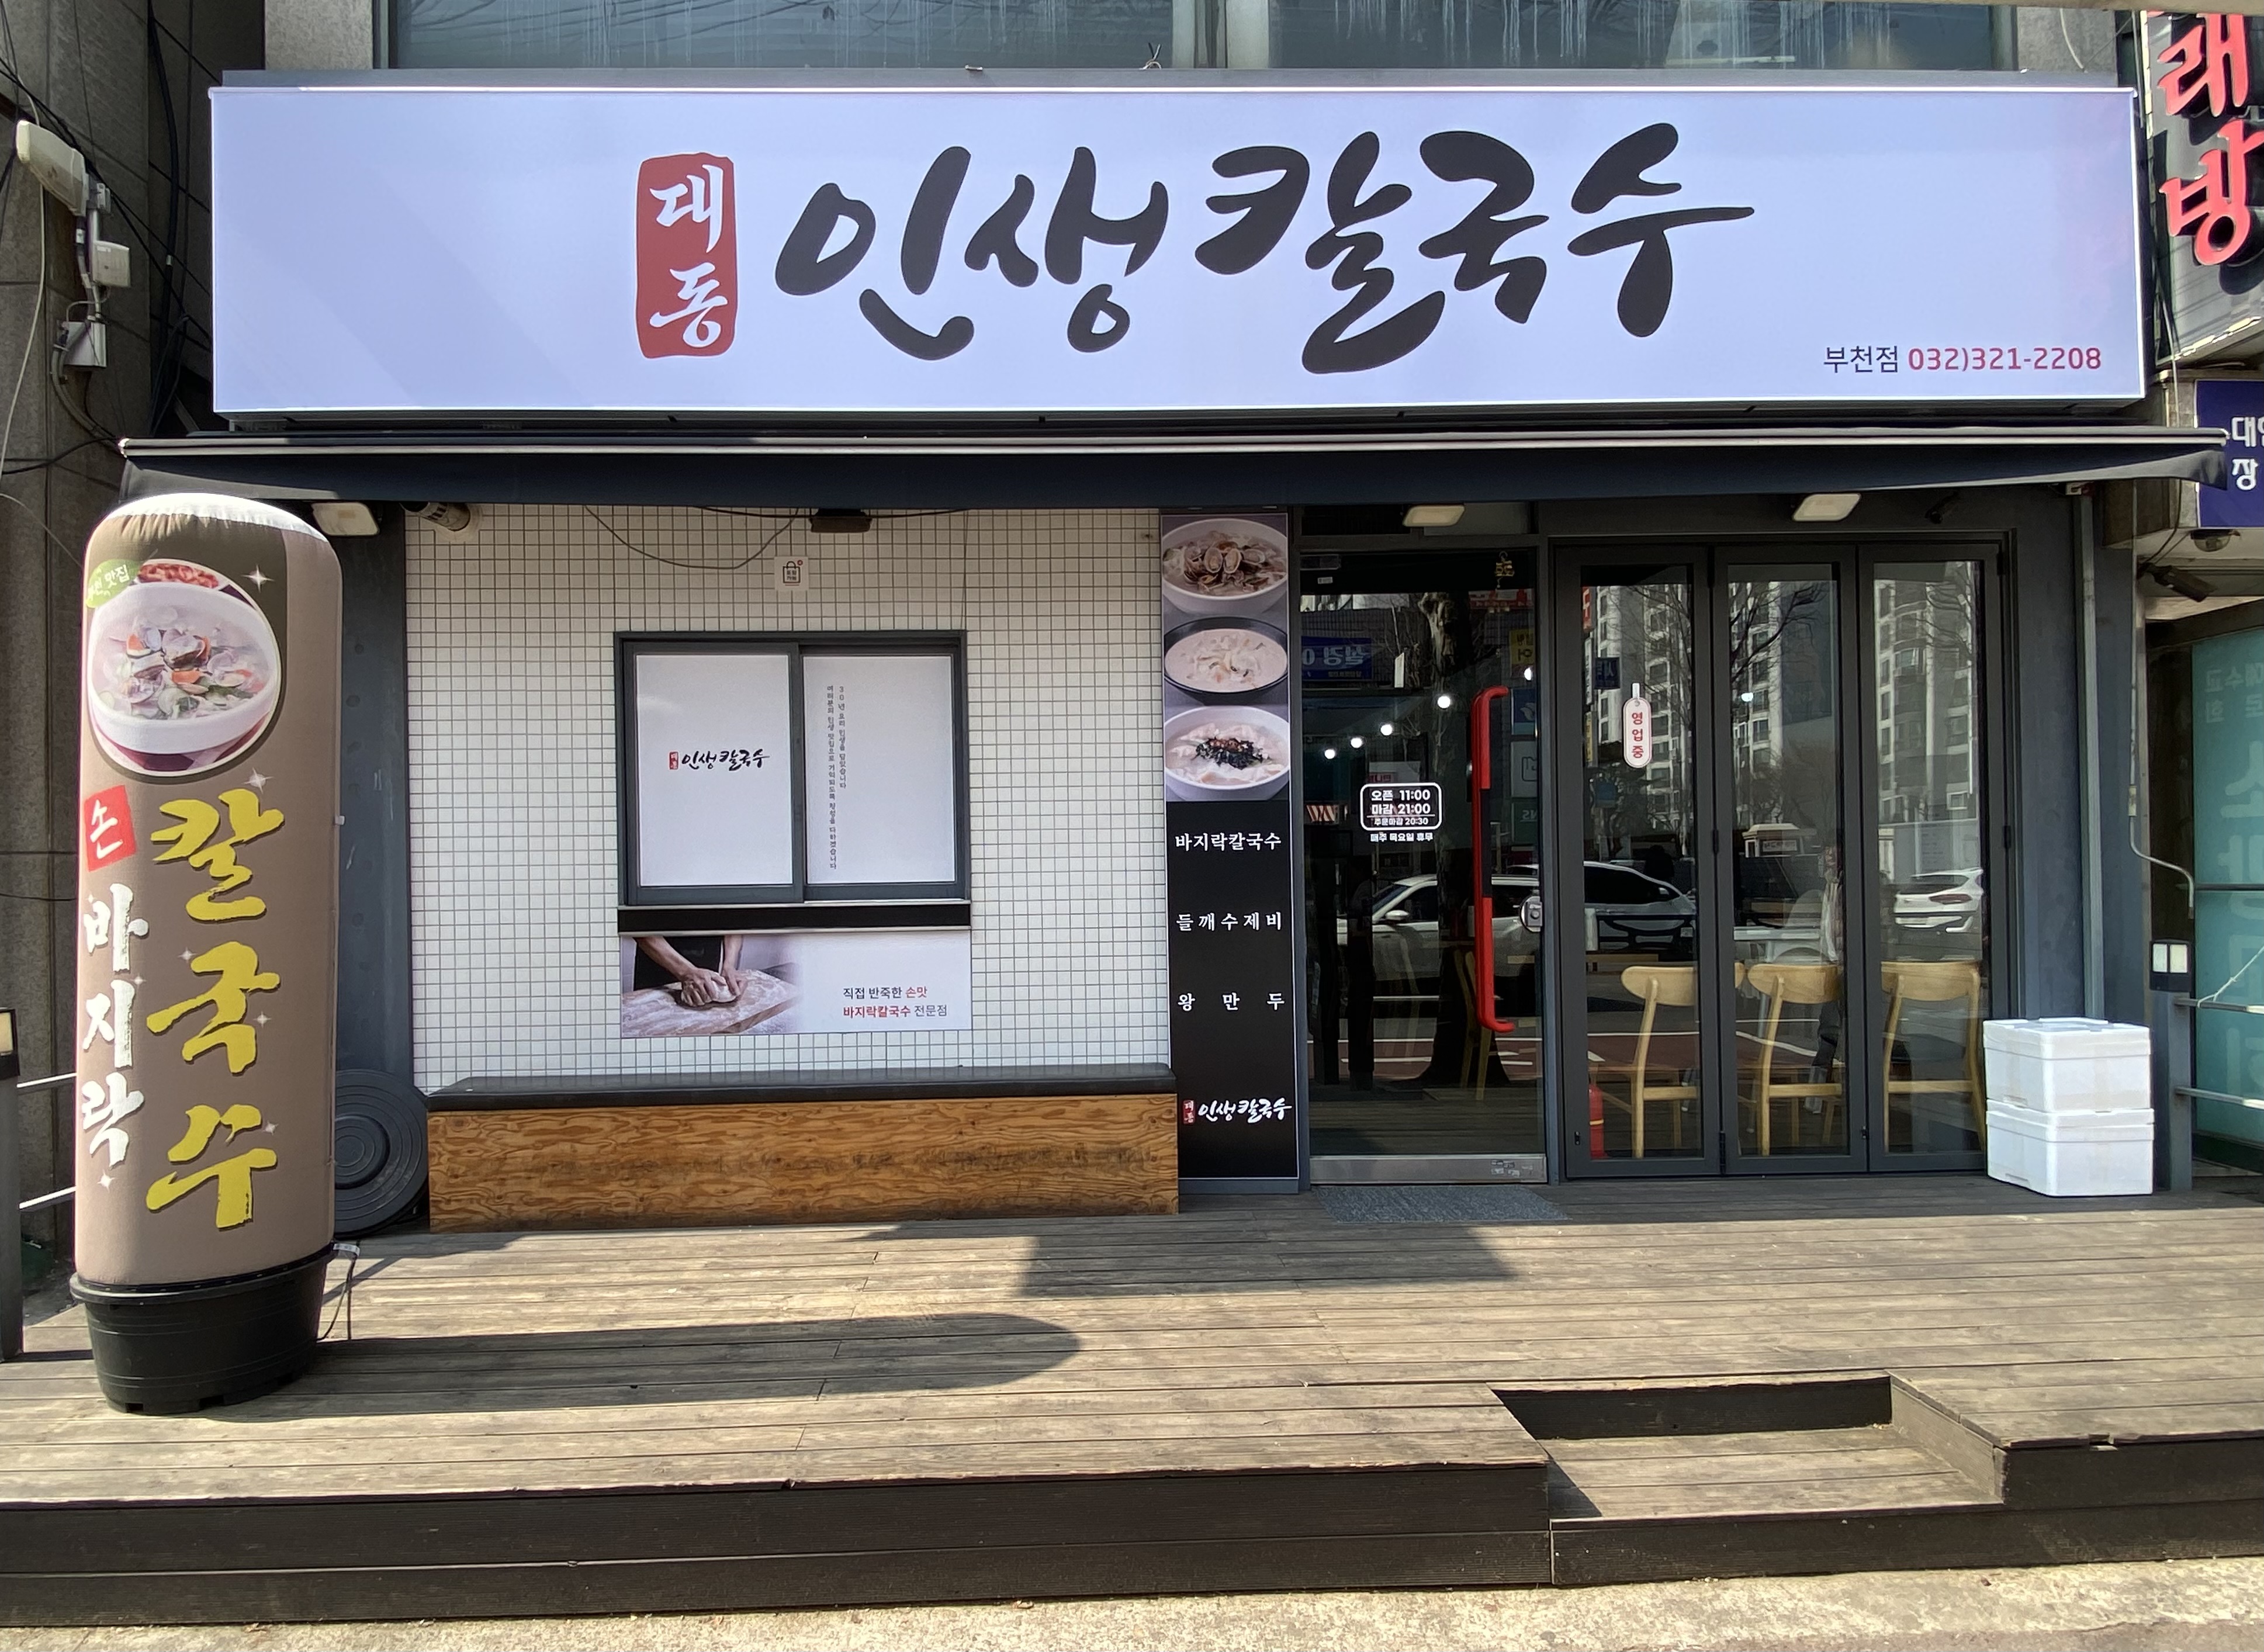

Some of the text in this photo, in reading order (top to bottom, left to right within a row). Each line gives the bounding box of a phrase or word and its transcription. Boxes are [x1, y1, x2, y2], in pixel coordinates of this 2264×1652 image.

[2156, 11, 2264, 266] 래방
[649, 164, 728, 348] 대동
[1823, 345, 2102, 373] 부천점 032)321-2208
[104, 564, 130, 589] 맛집
[1631, 712, 1644, 759] 영업중
[1371, 789, 1431, 801] 오픈 11:00
[1371, 803, 1431, 815] 마감 21:00
[1405, 817, 1428, 825] 20:30
[90, 798, 123, 860] 손
[1175, 832, 1282, 851] 바지락칼국수
[843, 986, 928, 1000] 직접 반죽한 손맛
[146, 788, 285, 1230] 칼국수
[843, 1004, 947, 1019] 바지락칼국수 전문점
[82, 882, 149, 1168] 바지락
